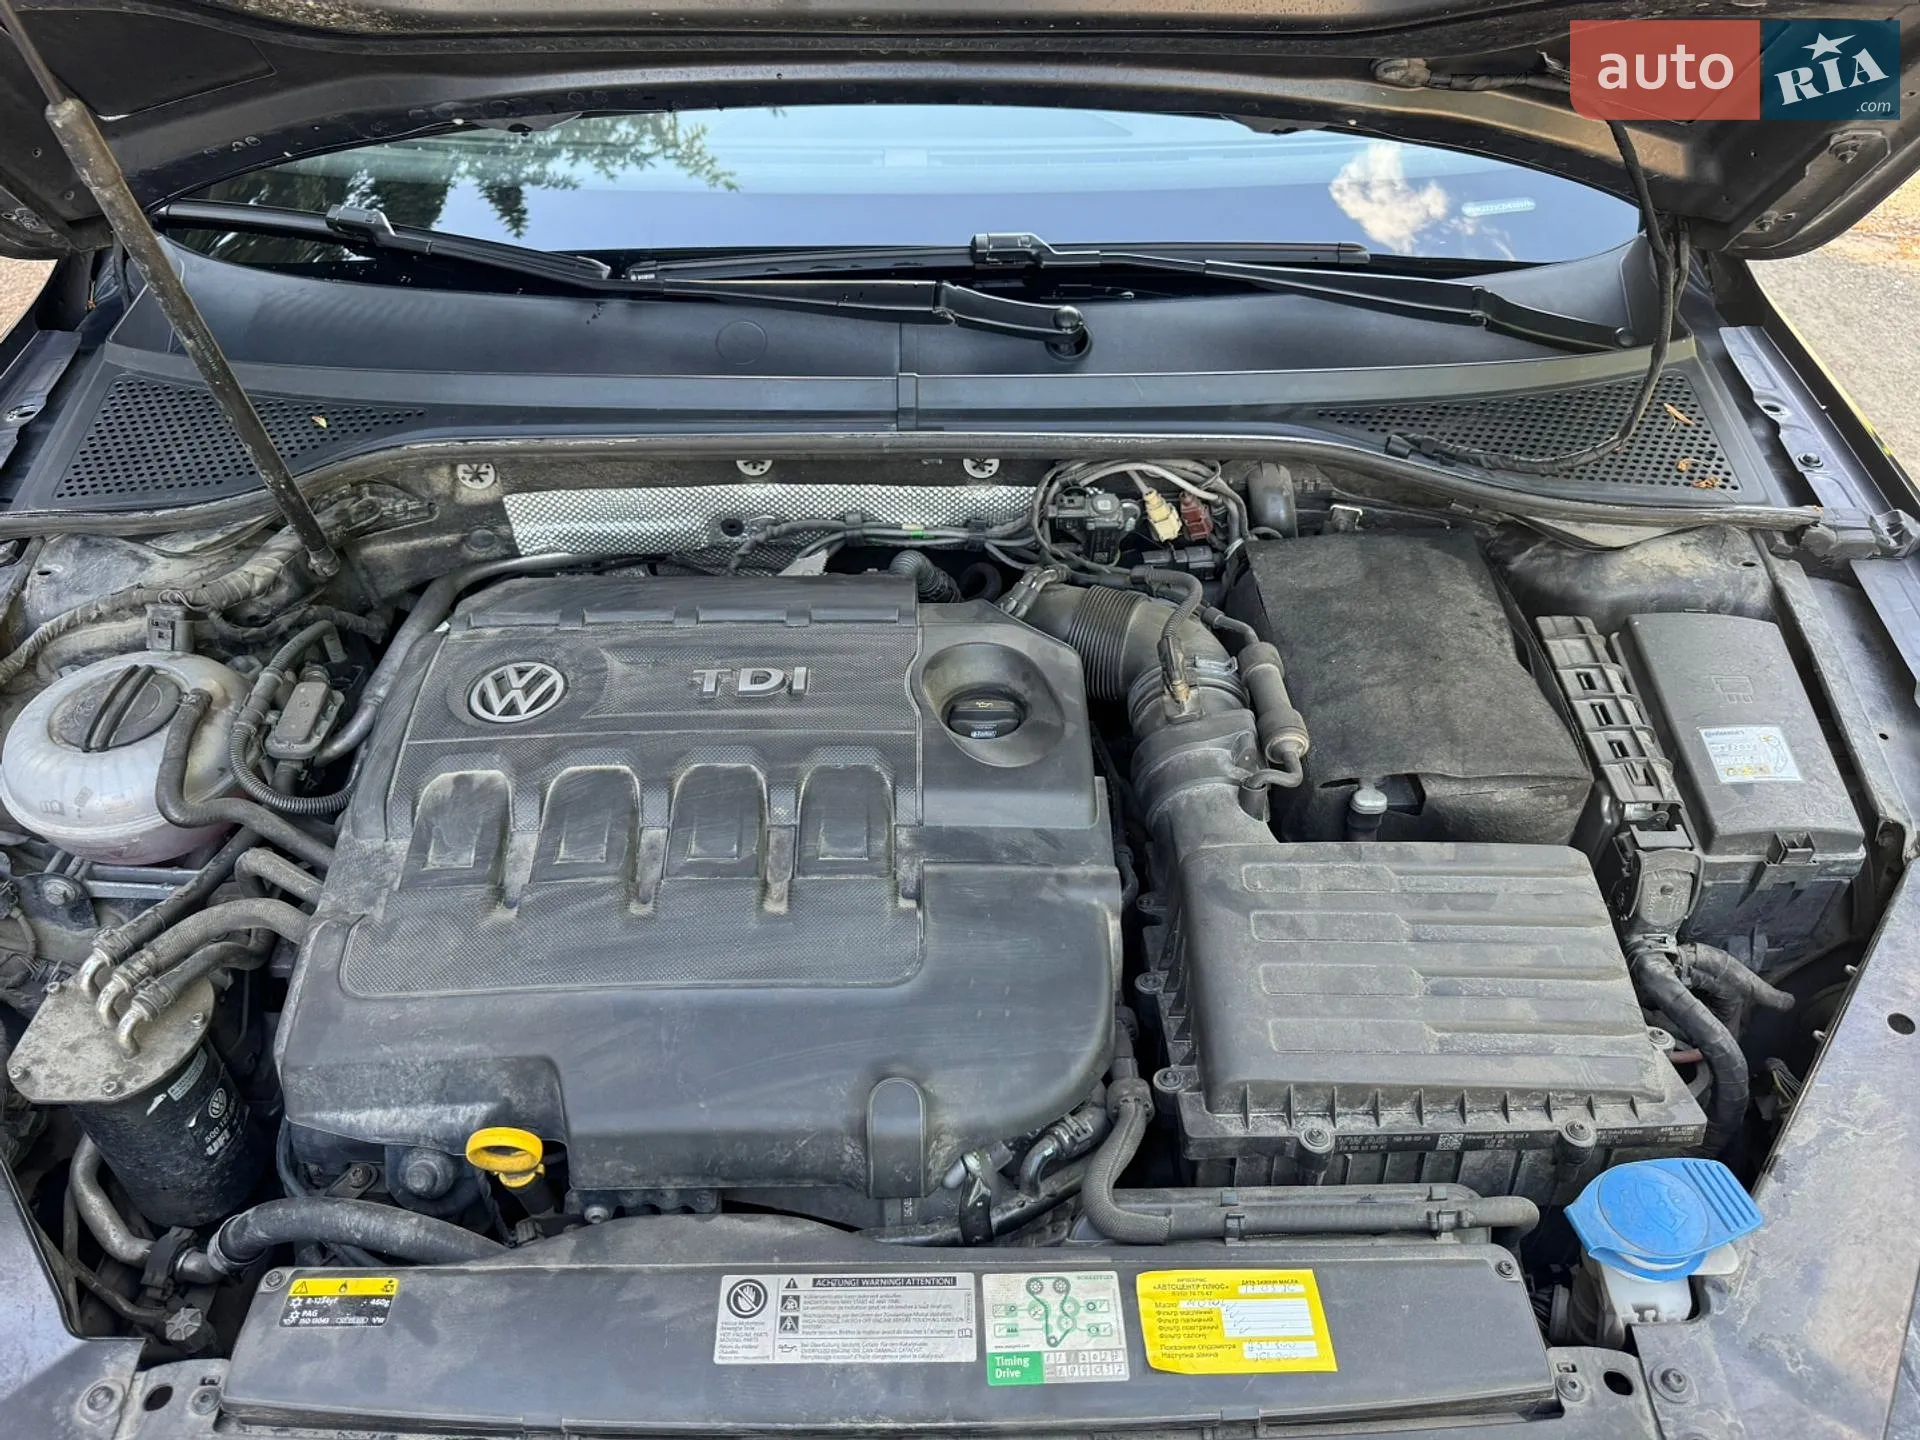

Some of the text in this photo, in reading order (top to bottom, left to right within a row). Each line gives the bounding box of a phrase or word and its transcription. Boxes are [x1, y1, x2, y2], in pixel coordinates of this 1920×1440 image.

[693, 666, 811, 698] TDI
[816, 1277, 954, 1287] ACHTUNG! WARNING! ATTENTION!
[301, 1309, 319, 1317] PAG
[995, 1356, 1030, 1368] Timing
[995, 1367, 1022, 1379] Drive
